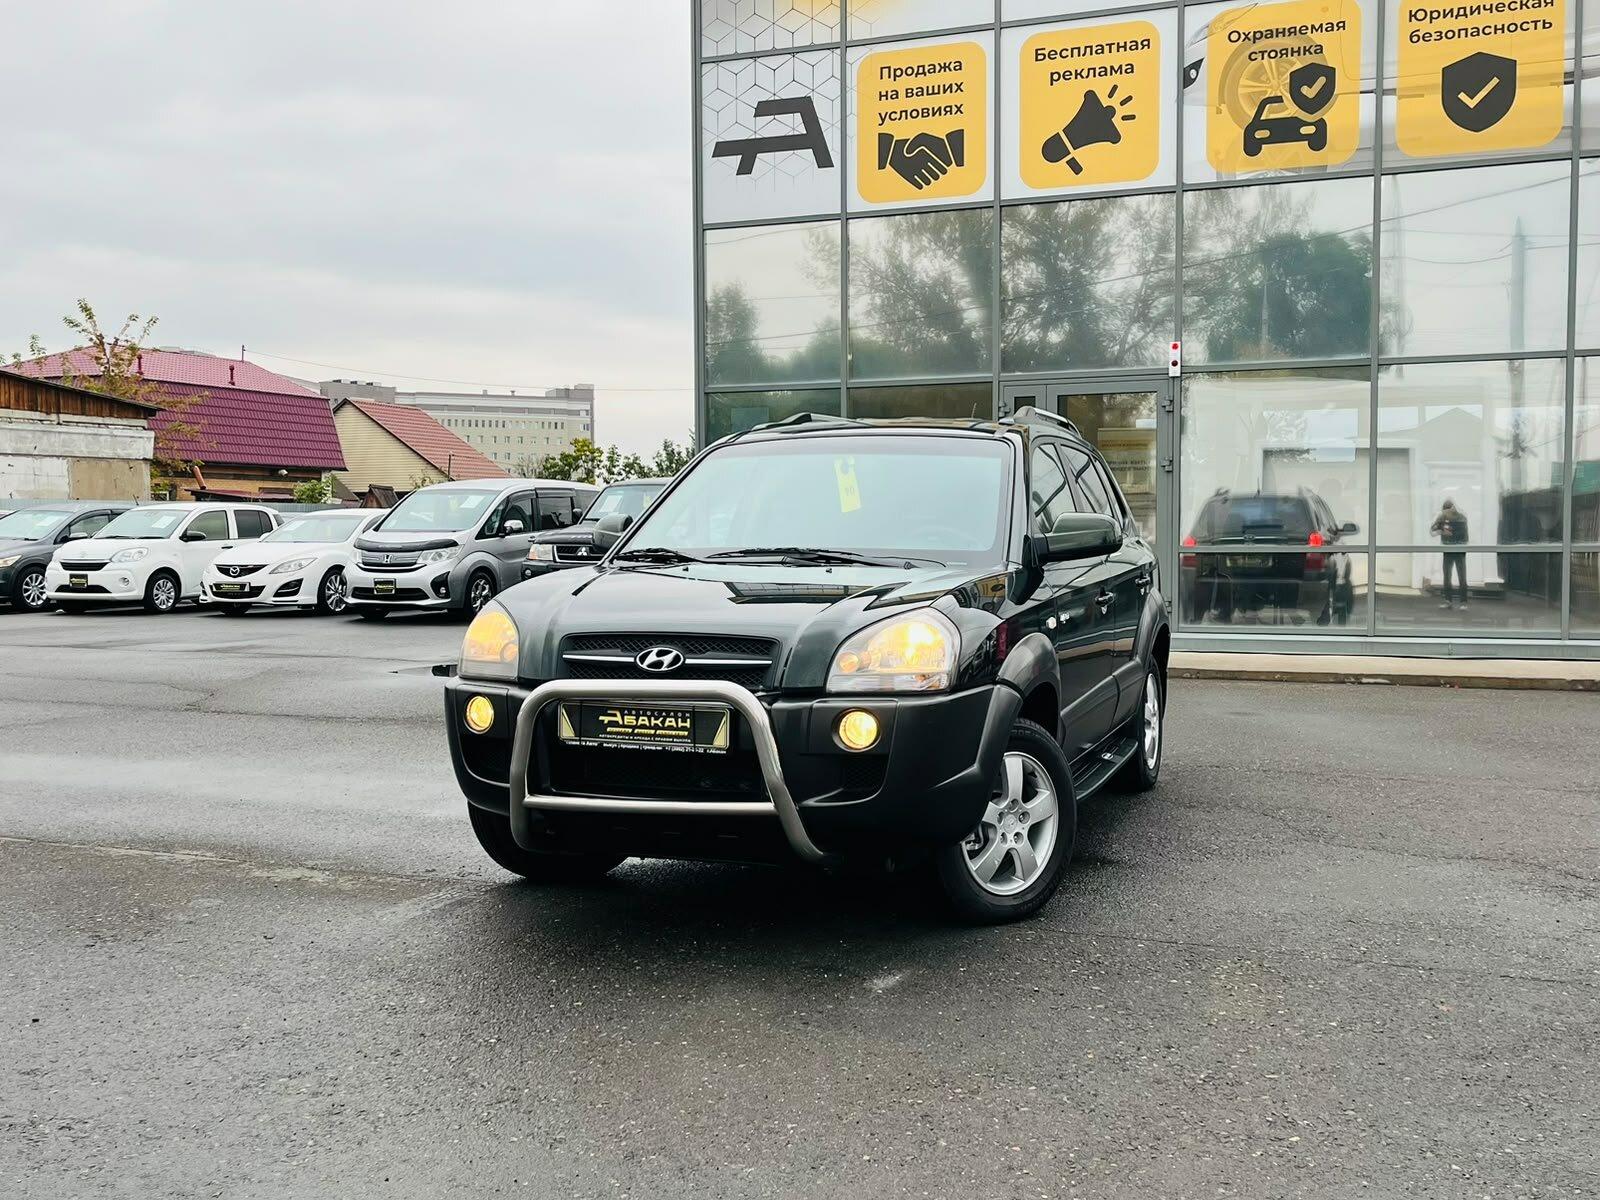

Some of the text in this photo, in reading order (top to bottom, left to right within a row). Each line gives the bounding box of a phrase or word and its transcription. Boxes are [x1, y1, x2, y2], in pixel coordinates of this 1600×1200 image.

[1408, 0, 1554, 24] Юридическая
[1227, 20, 1346, 44] Охраняемая
[1409, 19, 1553, 44] безопасность
[1034, 38, 1151, 62] Бесплатная
[1247, 44, 1324, 62] стоянка
[879, 60, 963, 80] Продажа
[1049, 63, 1135, 87] реклама
[878, 81, 964, 102] на ваших
[878, 103, 964, 127] условиях
[623, 709, 691, 718] АВТОСАЛОН
